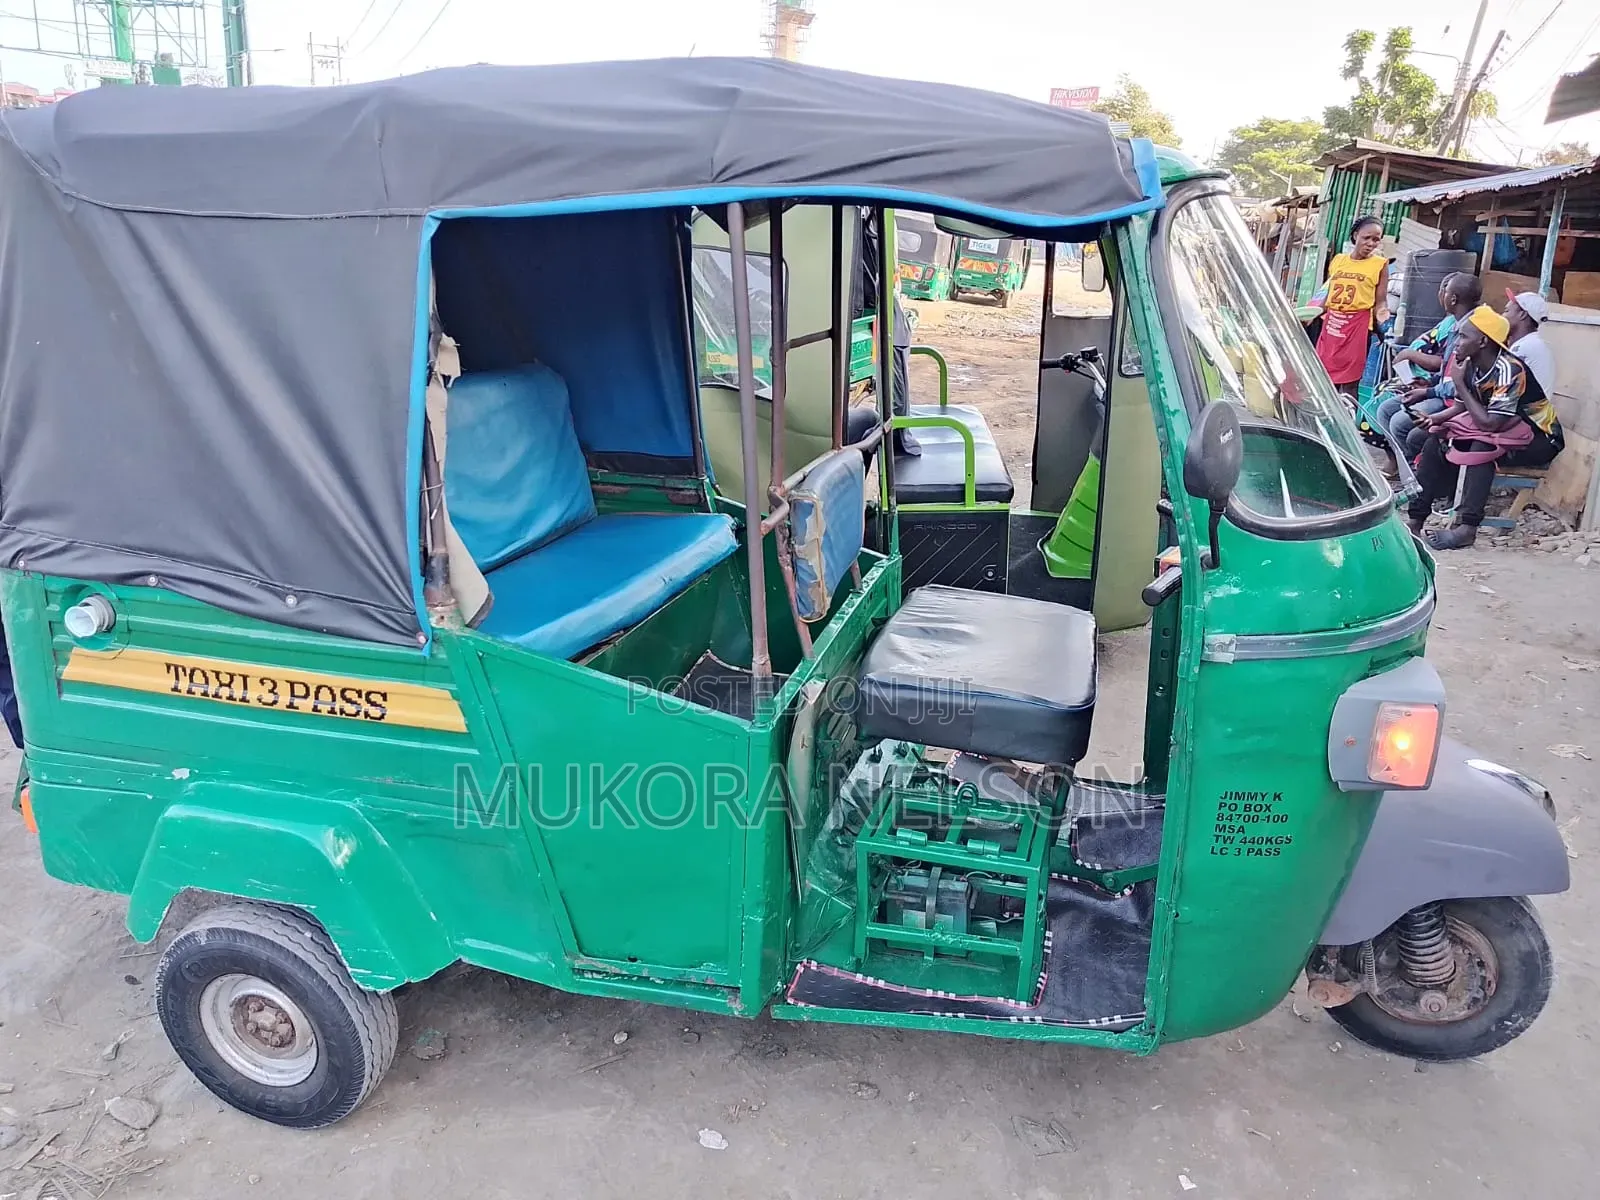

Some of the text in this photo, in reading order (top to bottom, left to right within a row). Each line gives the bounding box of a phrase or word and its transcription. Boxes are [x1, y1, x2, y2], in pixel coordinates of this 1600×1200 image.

[1331, 284, 1356, 305] 23
[165, 662, 388, 721] TAXI 3 PASS
[1219, 791, 1283, 801] JIMMY K
[1218, 802, 1272, 813] PO BOX
[1216, 813, 1288, 824] 84700-100
[1214, 824, 1245, 834] MSA
[1213, 834, 1292, 845] TW 440KGS
[1210, 846, 1281, 856] LC 3 PASS
